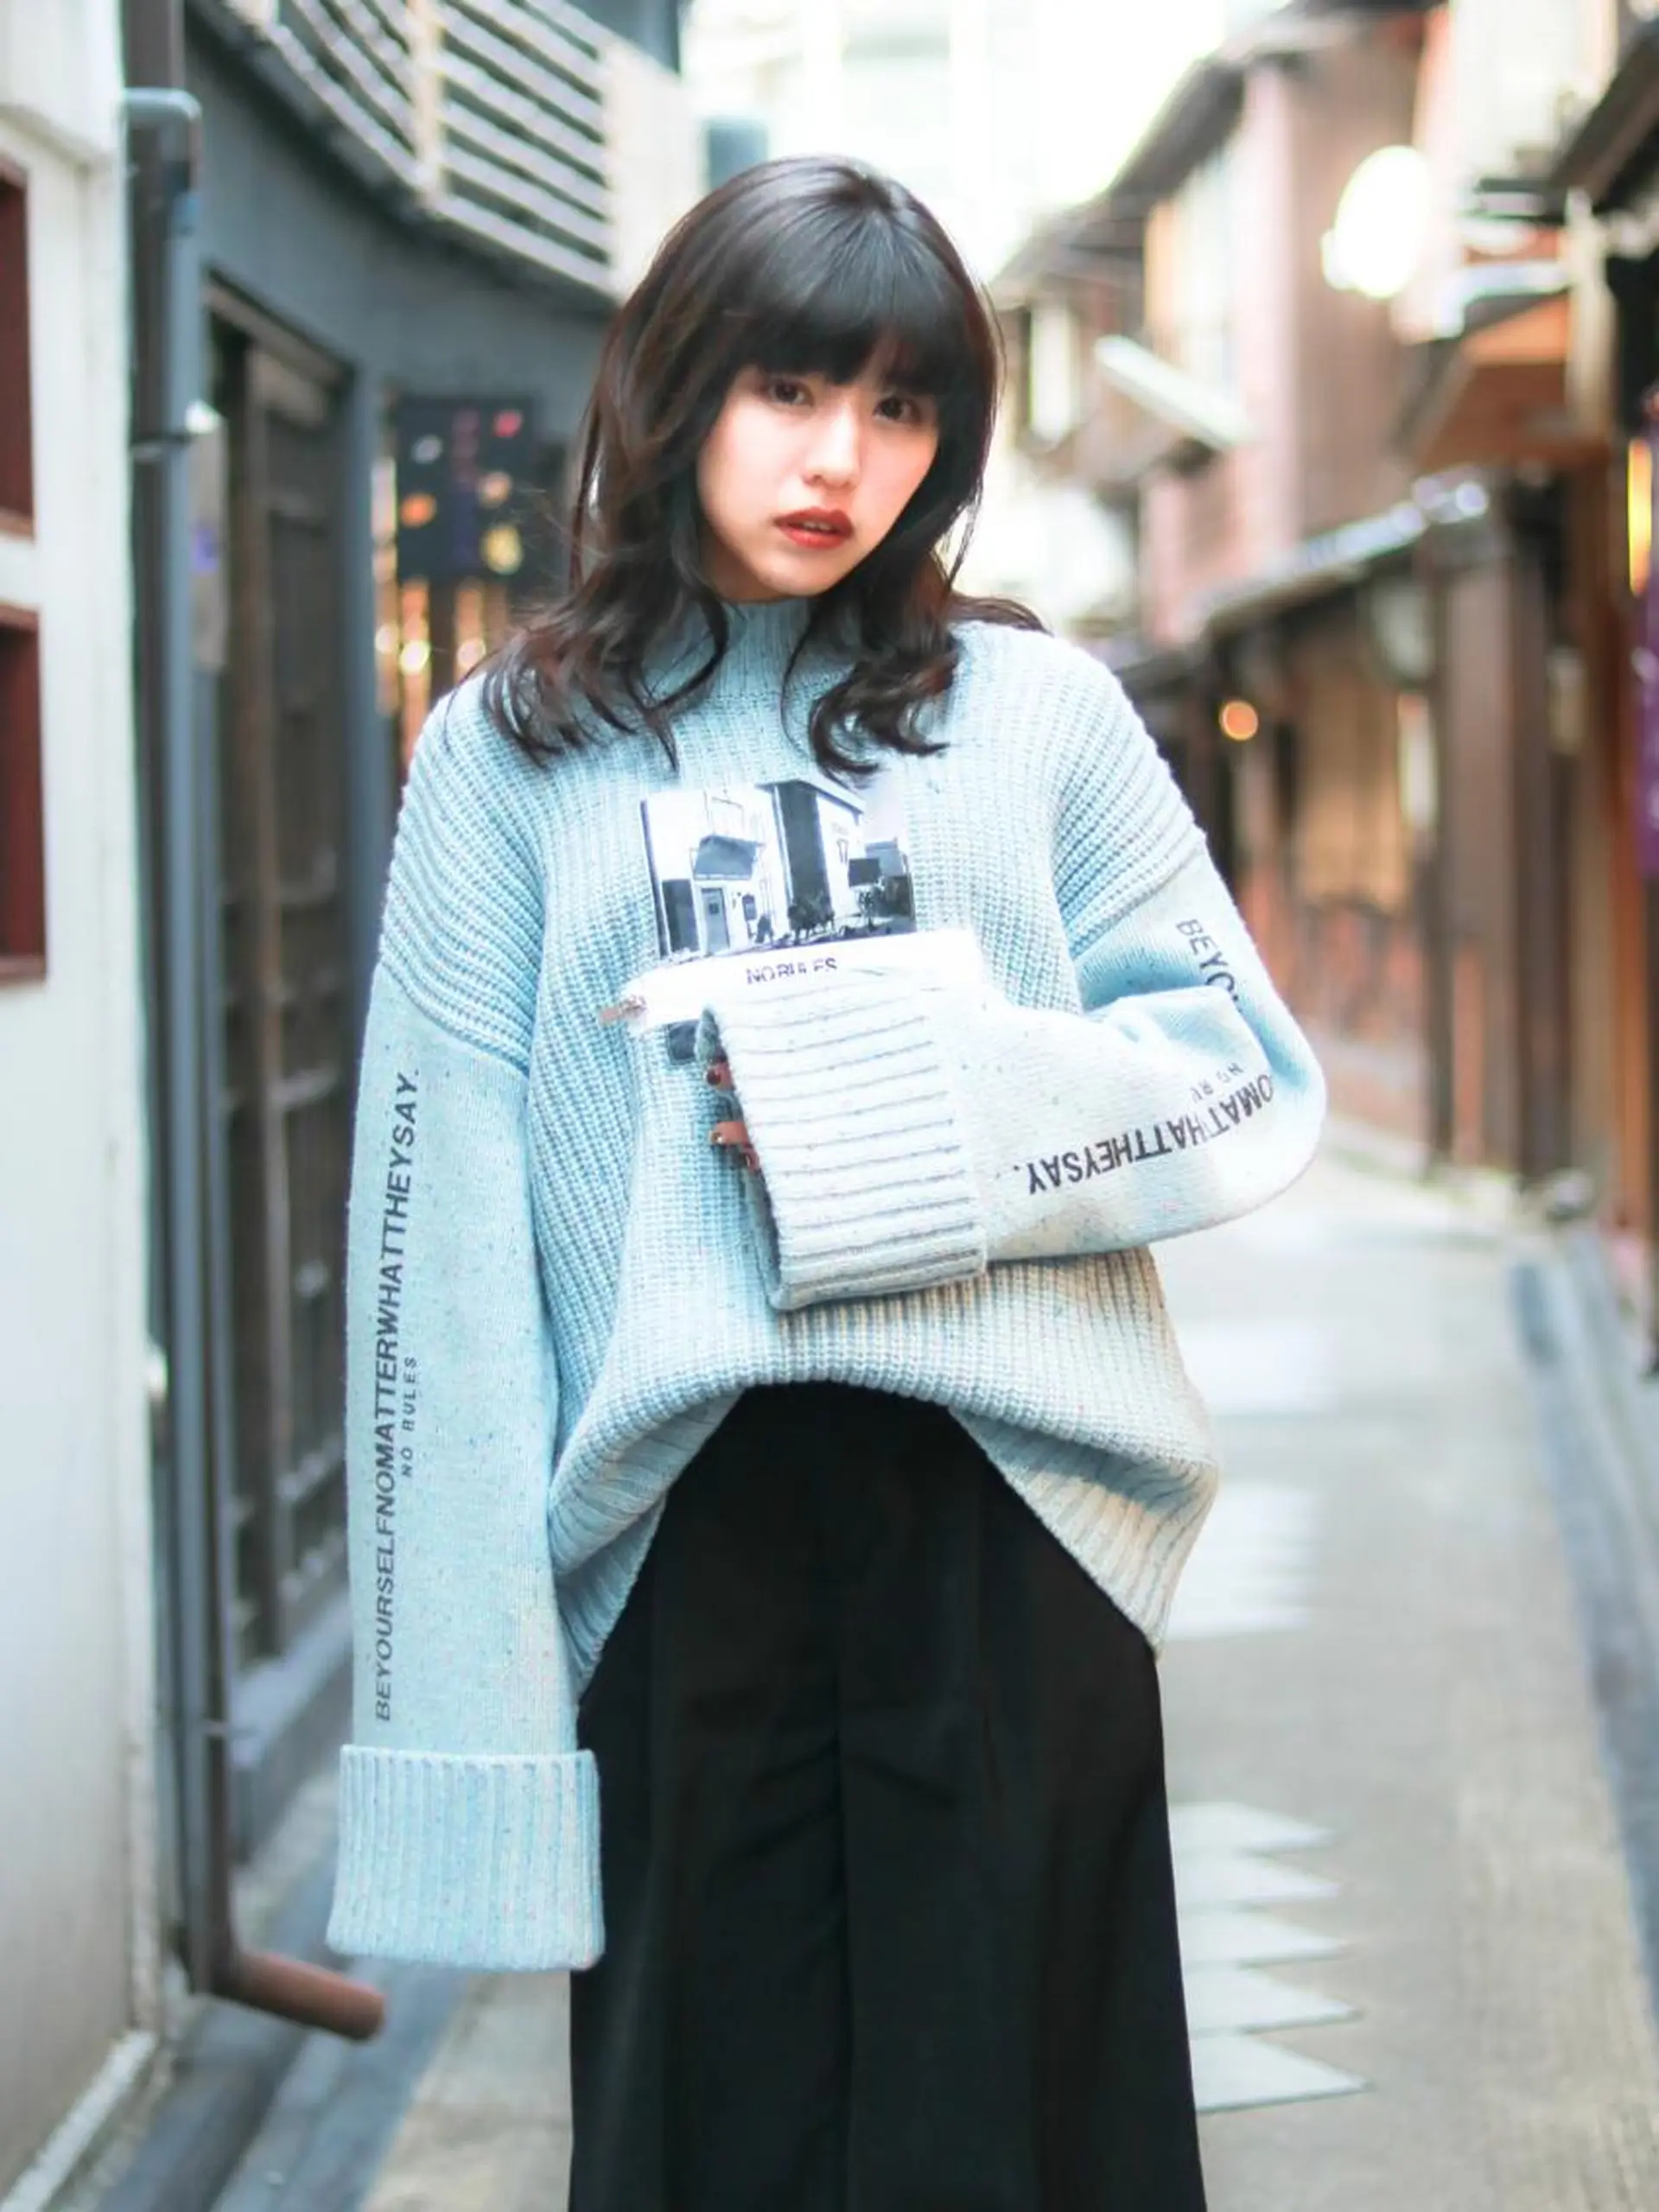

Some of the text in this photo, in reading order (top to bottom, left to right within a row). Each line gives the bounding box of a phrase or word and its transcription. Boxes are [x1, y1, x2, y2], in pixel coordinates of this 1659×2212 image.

[375, 1068, 419, 1721] BEYOURSELFNOMATTERWHATTHEYSAY.
[400, 1357, 416, 1478] NO RULES
